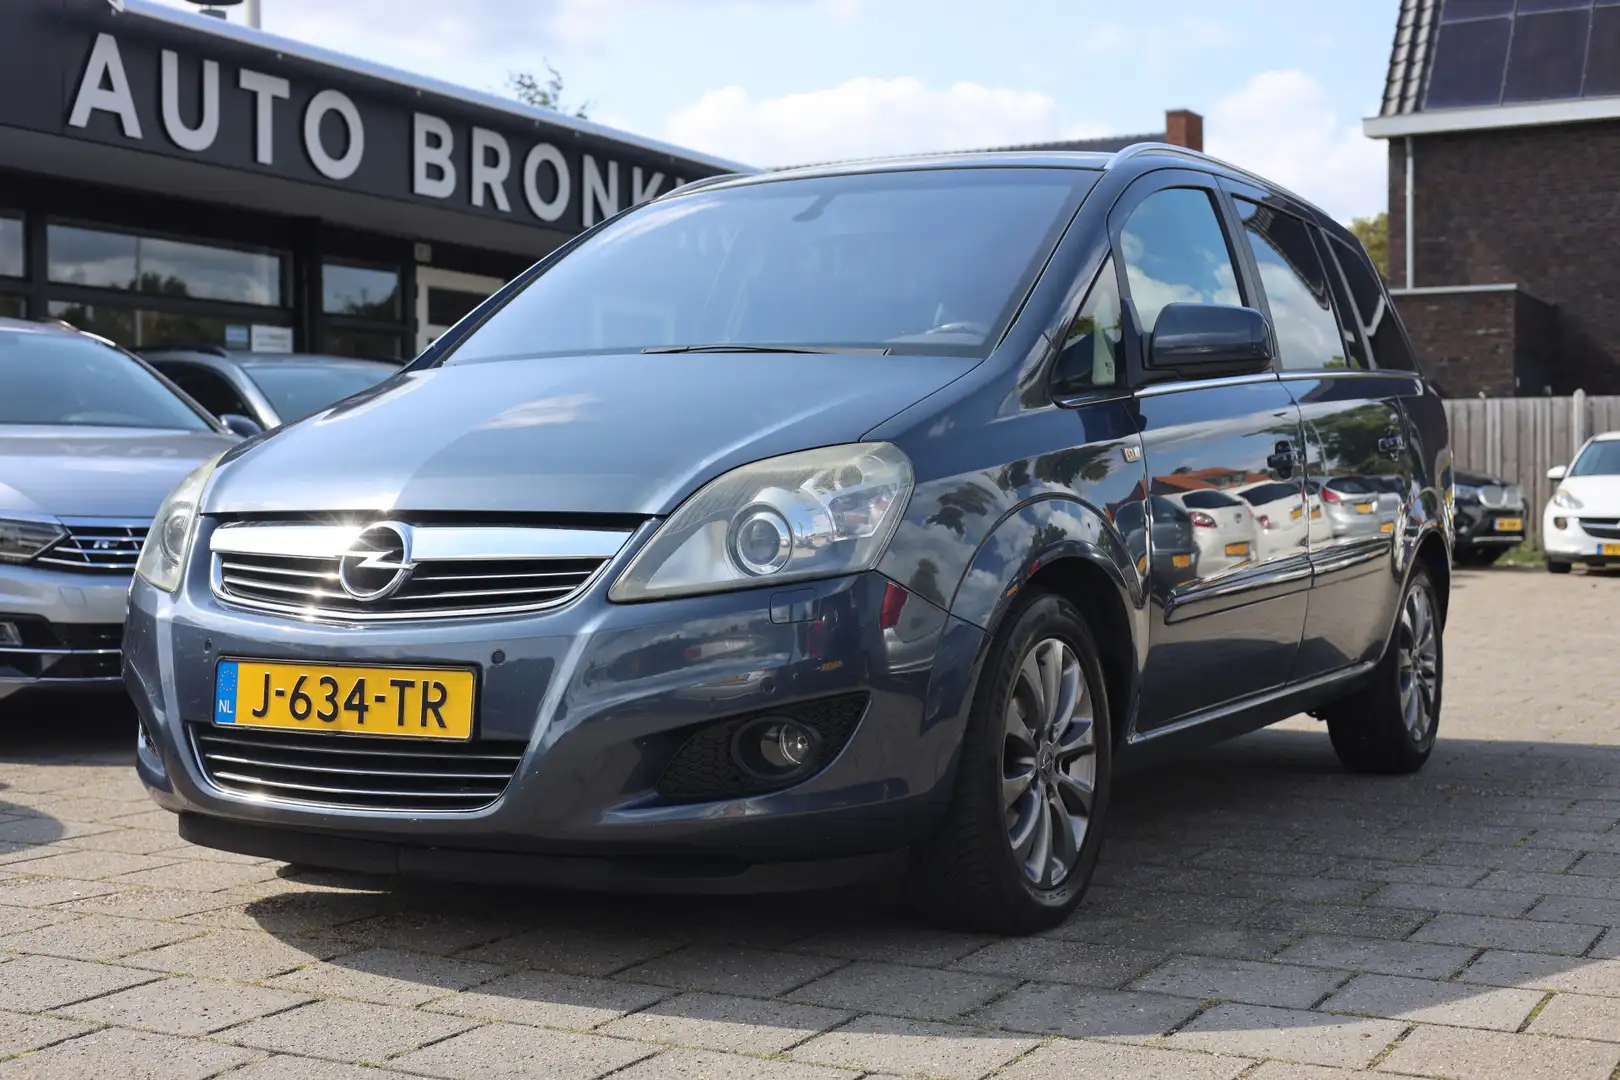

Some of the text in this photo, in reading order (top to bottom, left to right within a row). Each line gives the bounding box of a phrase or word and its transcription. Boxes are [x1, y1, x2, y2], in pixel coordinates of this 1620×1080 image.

[69, 32, 686, 228] AUTO BRONK
[219, 699, 233, 714] NL
[252, 672, 447, 728] J-634-TR
